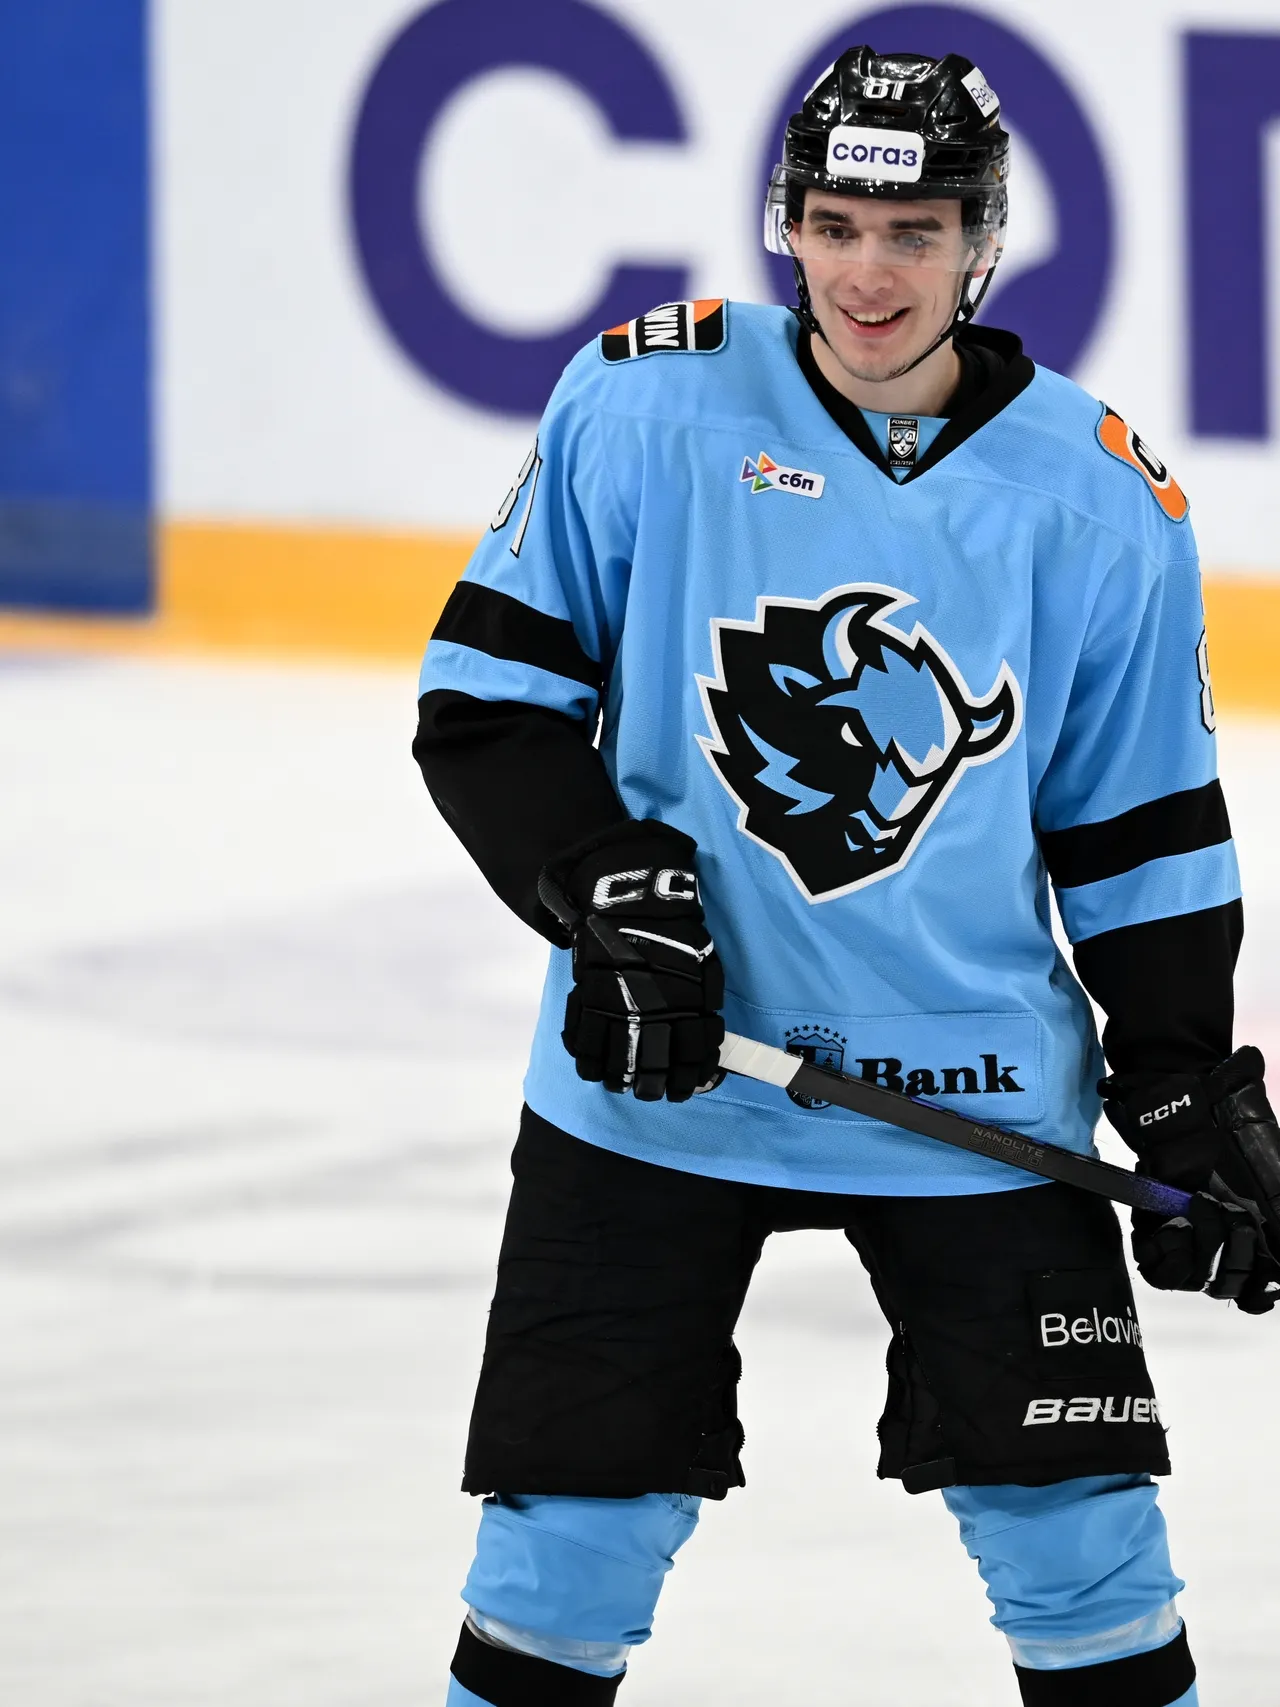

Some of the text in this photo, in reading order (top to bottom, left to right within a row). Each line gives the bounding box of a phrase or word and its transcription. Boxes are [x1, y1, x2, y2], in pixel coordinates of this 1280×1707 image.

[862, 78, 907, 101] 81
[832, 142, 919, 168] согаз
[644, 305, 680, 348] WIN
[778, 472, 815, 492] сбп
[592, 867, 703, 910] CC
[855, 1053, 1026, 1097] Bank
[1139, 1093, 1192, 1127] CCM
[973, 1127, 1045, 1159] NANOLITE
